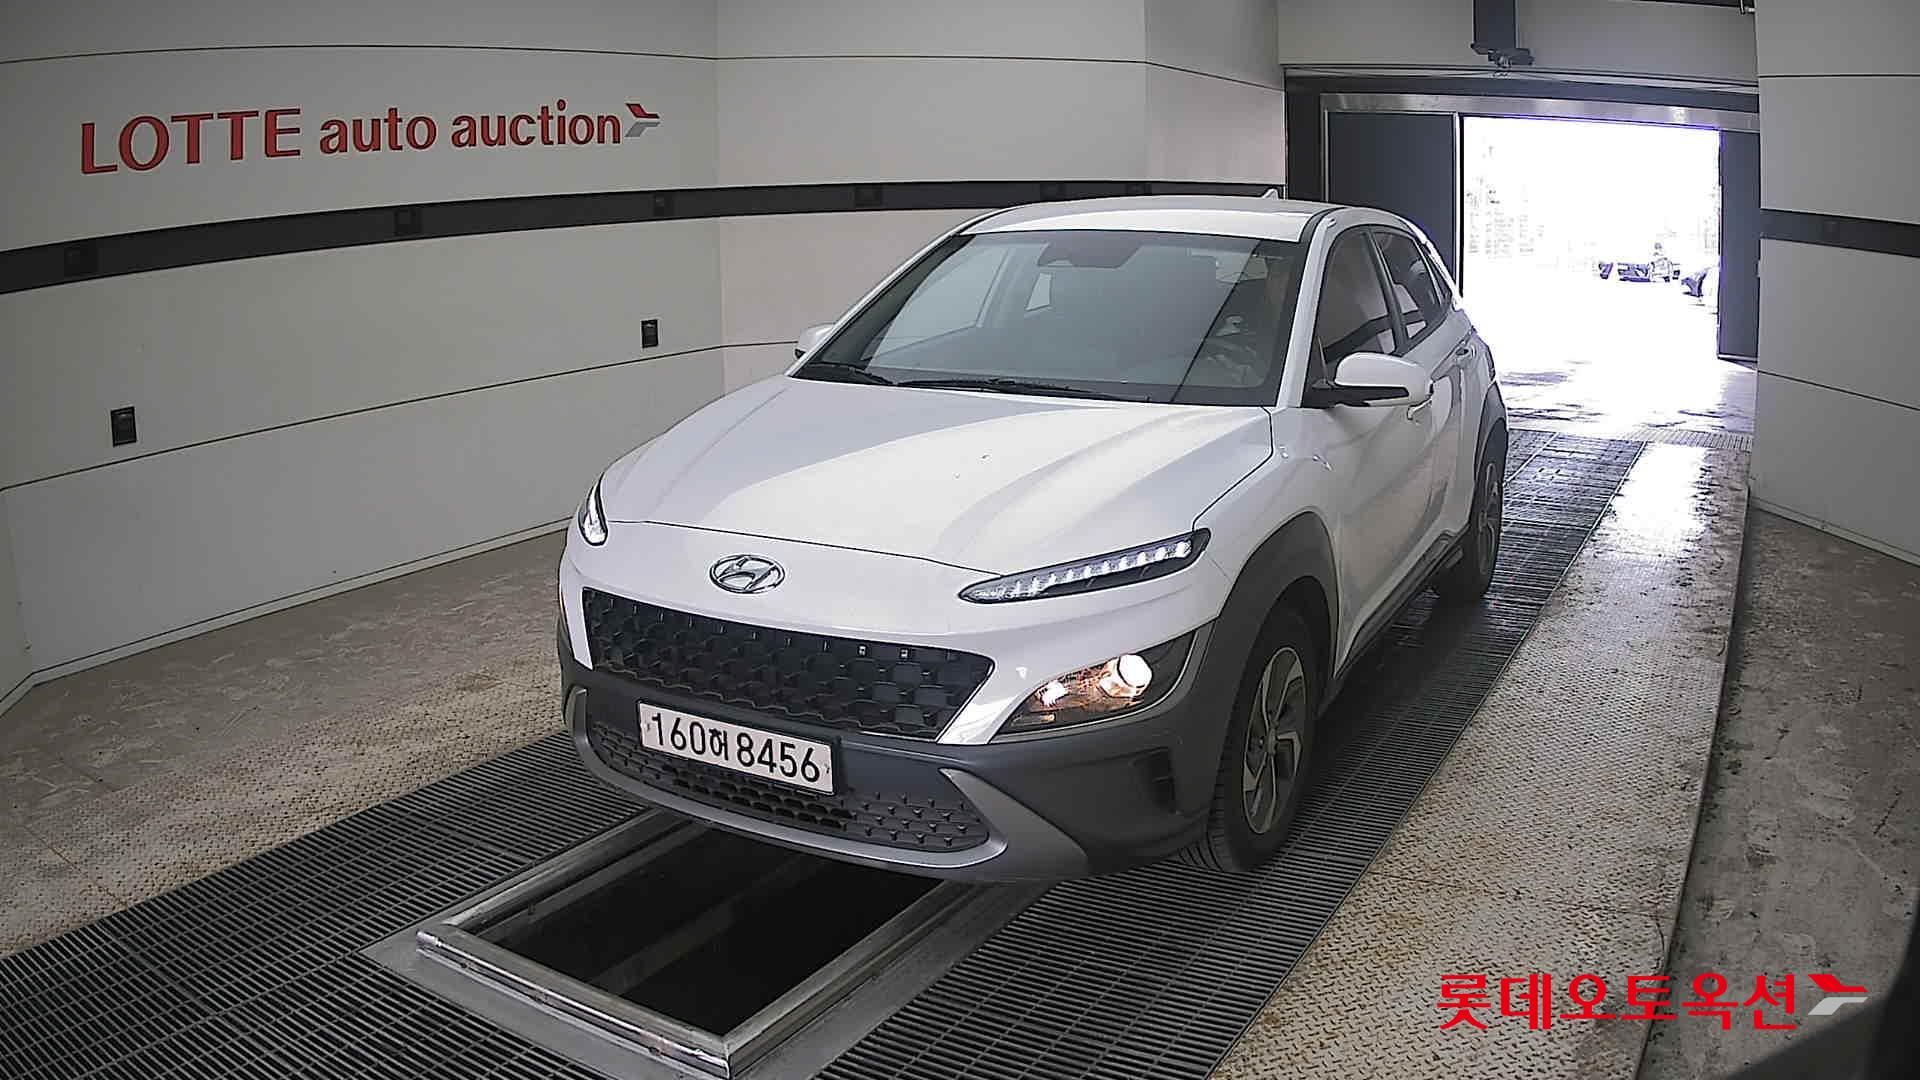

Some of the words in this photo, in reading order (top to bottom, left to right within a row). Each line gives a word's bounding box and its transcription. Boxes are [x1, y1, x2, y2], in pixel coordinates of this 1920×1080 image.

[81, 108, 301, 174] LOTTE
[319, 107, 437, 155] auto
[450, 99, 622, 148] auction
